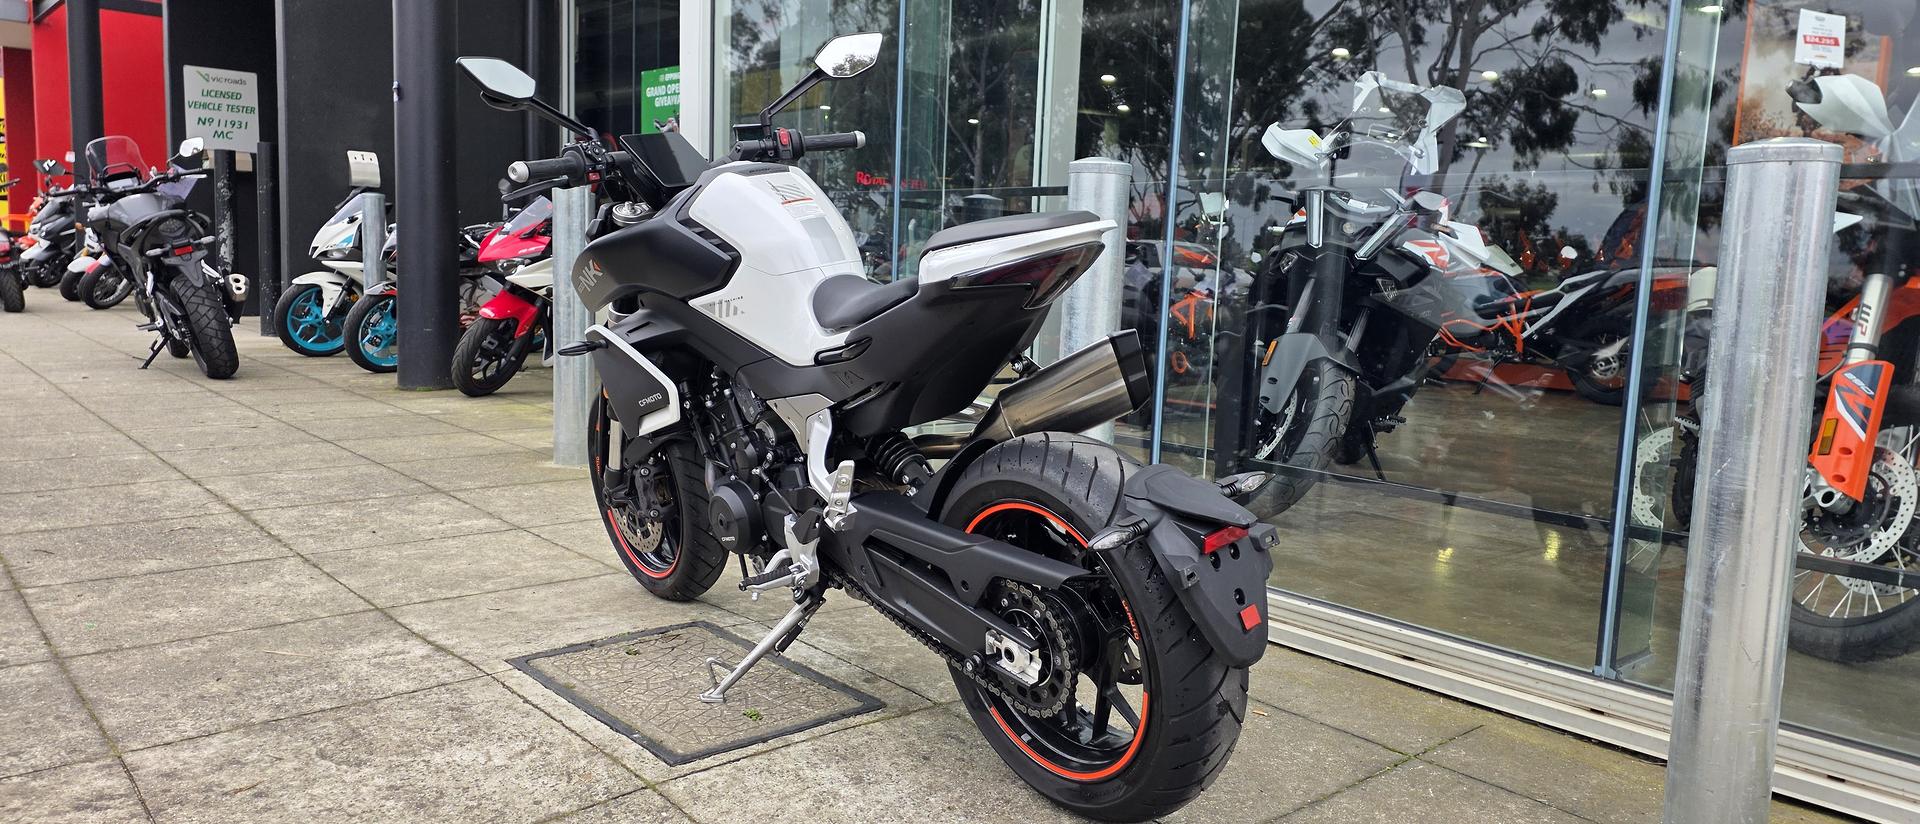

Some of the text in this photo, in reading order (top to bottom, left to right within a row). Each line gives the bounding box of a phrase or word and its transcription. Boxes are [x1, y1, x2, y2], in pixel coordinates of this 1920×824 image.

[201, 88, 242, 100] LICENSED
[667, 82, 680, 94] OPE
[187, 100, 256, 115] VEHICLE TESTER
[217, 118, 249, 130] 11931
[212, 130, 234, 140] MC
[638, 392, 663, 407] CFMOTO
